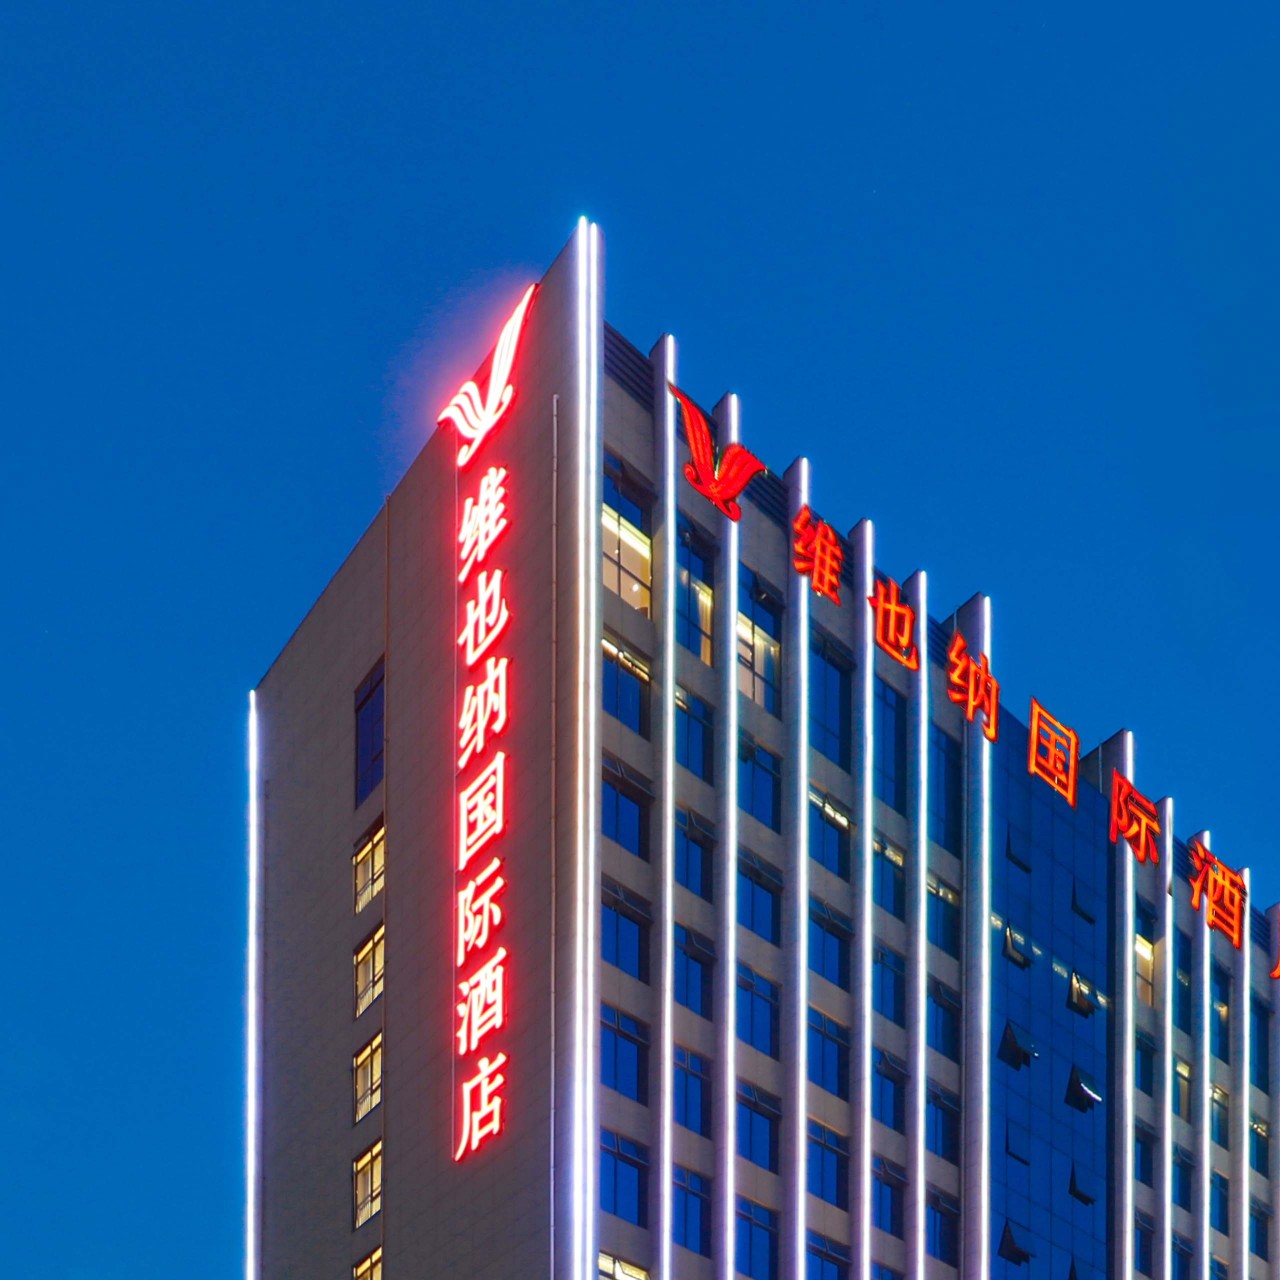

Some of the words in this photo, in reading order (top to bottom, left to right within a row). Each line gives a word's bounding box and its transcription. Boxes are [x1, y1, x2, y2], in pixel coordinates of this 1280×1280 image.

[454, 467, 510, 1162] 维也纳国际酒店
